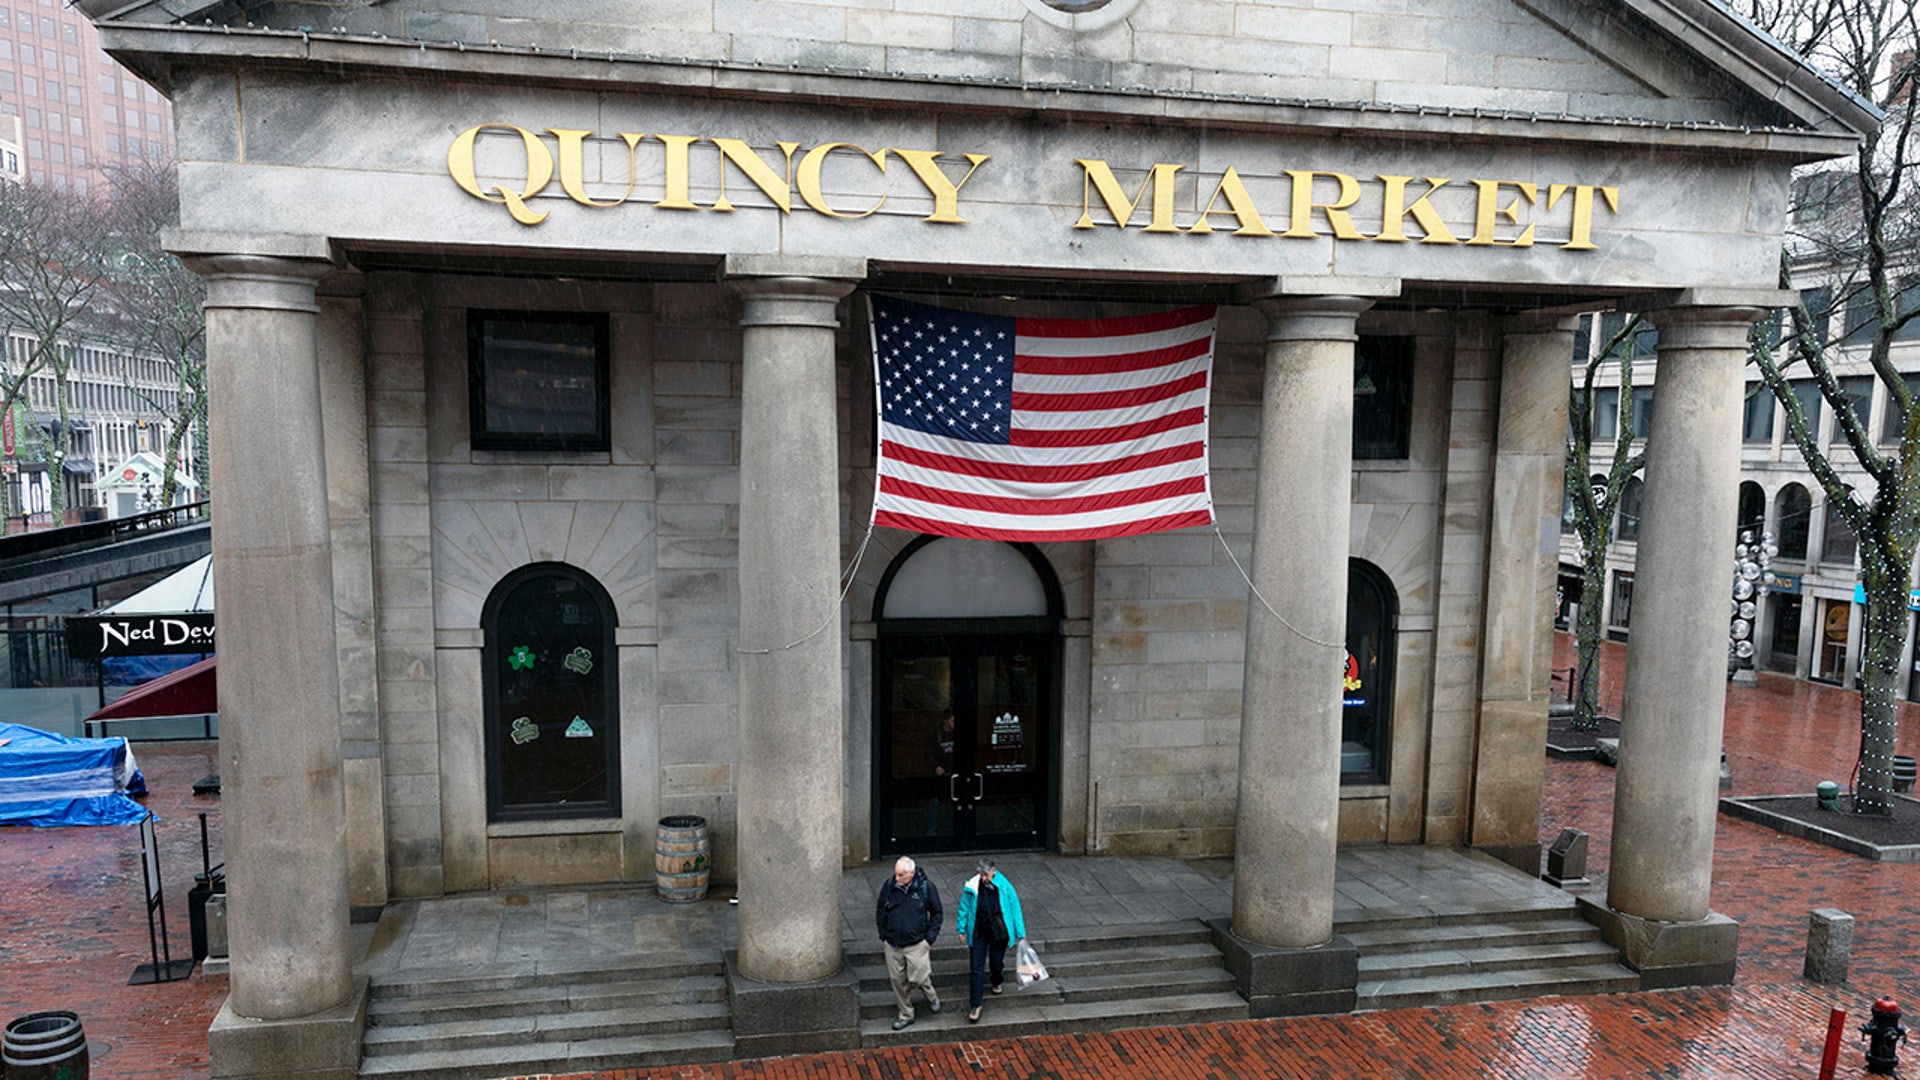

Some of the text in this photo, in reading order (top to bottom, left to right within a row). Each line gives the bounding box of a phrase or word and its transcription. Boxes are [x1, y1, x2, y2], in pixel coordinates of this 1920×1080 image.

[447, 123, 1619, 250] QUINCY MARKET
[99, 619, 155, 652] Ned
